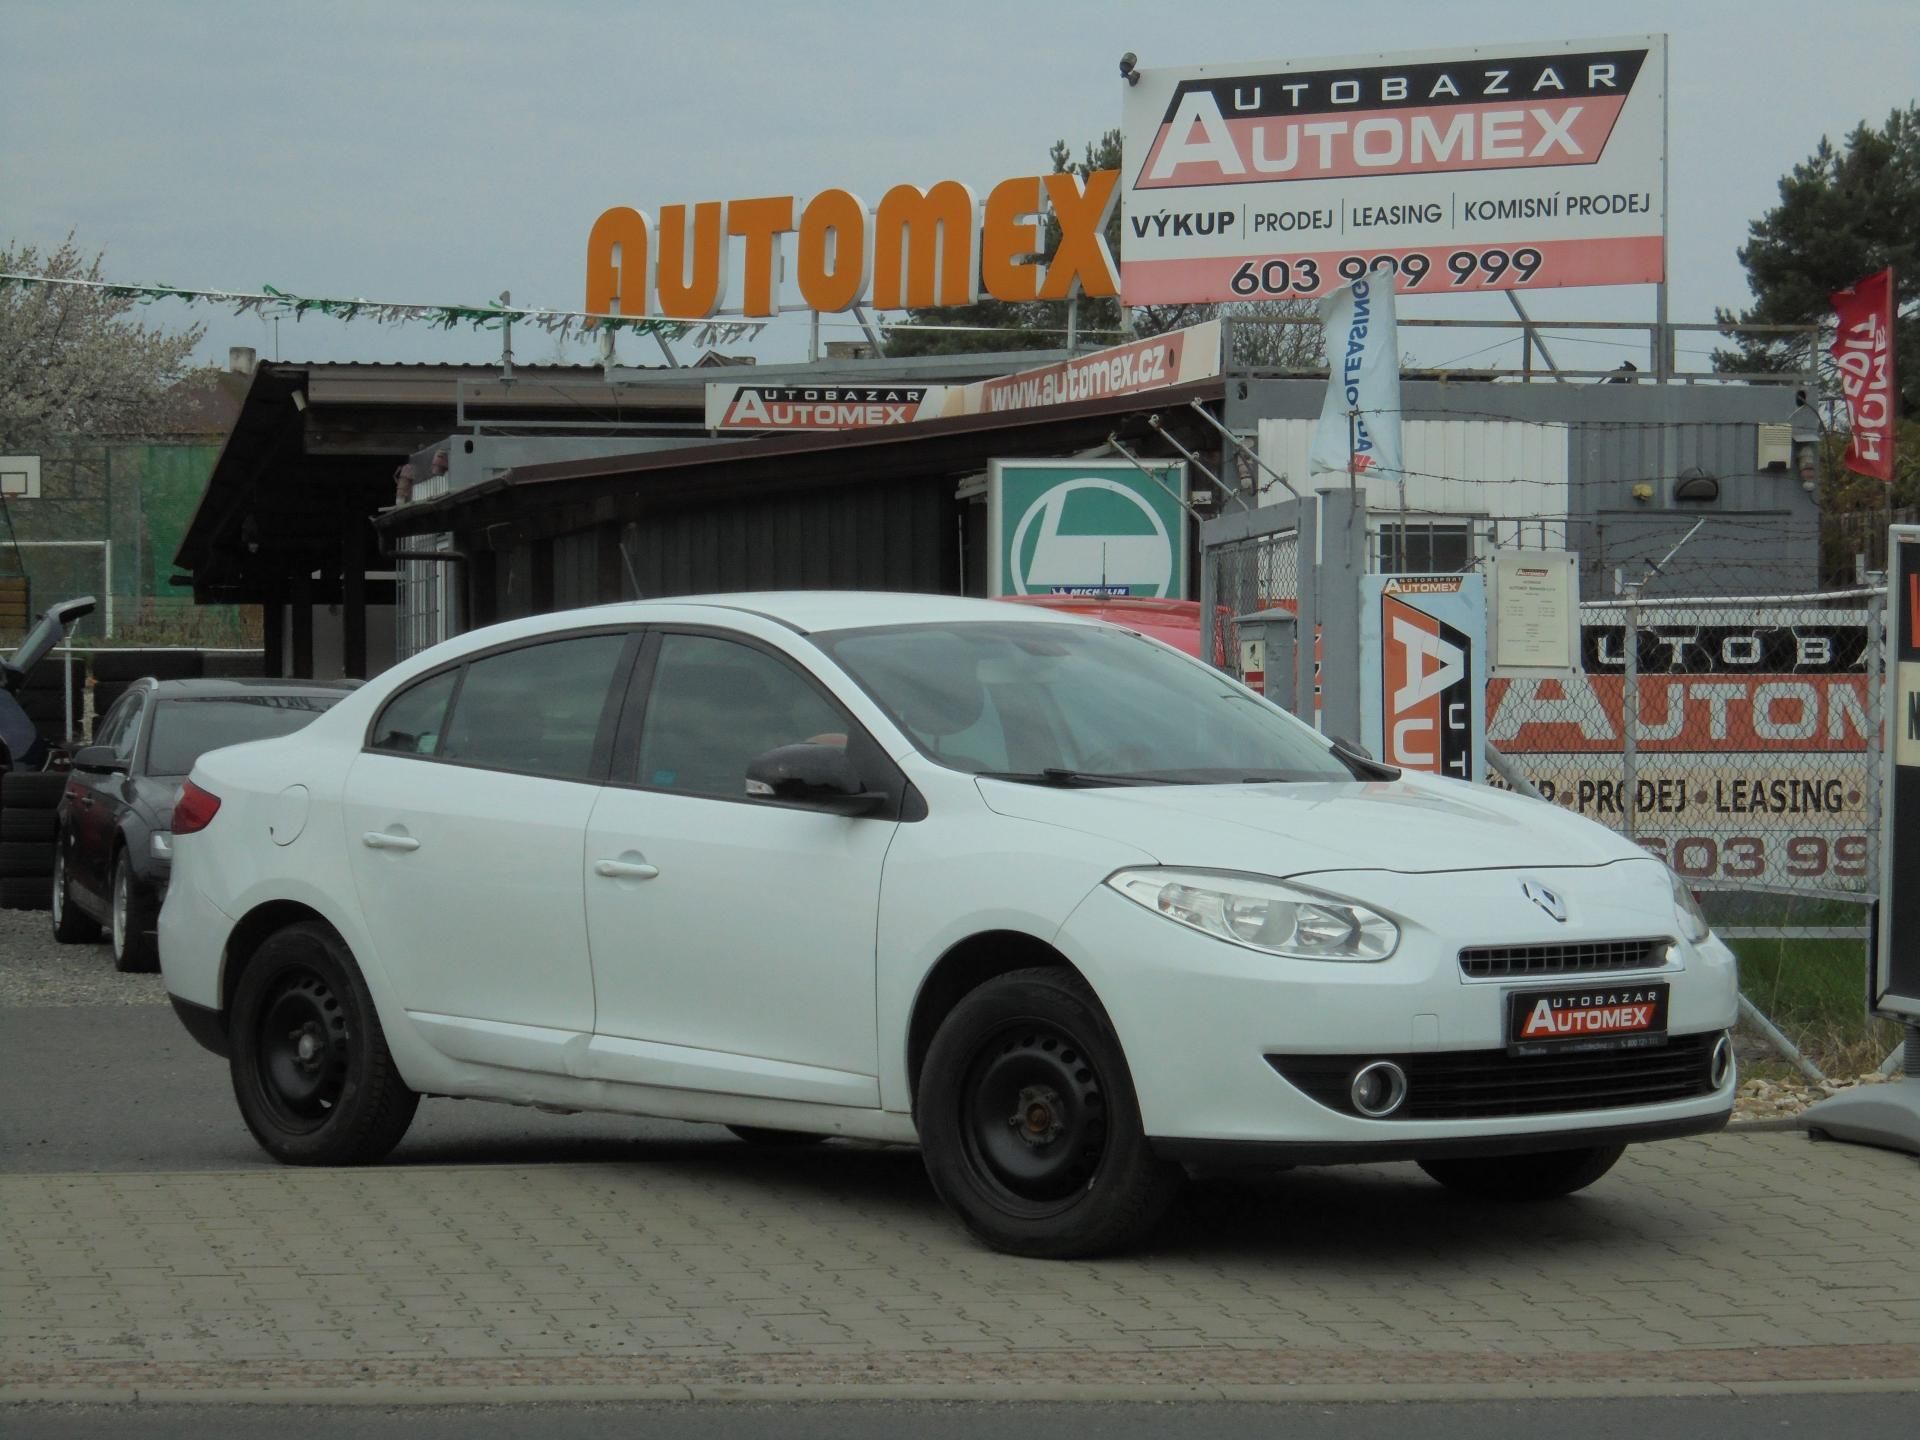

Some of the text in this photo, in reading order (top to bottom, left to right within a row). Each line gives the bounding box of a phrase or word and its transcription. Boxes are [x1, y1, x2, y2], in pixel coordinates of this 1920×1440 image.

[1149, 90, 1584, 180] AUTOMEX
[1131, 191, 1650, 239] VÝKUP PRODEJ LEASING KOMISNÍ PRODEJ
[585, 169, 1122, 328] AUTOMEX
[1231, 259, 1320, 295] 603
[1448, 248, 1542, 284] 999
[991, 344, 1165, 411] www.automex.cz
[730, 390, 906, 425] AUTOMEX
[1070, 588, 1126, 597] MICHLIN
[1384, 578, 1457, 593] AUTOMEX
[1716, 779, 1842, 814] LEASING
[1527, 999, 1647, 1033] AUTOMEX
